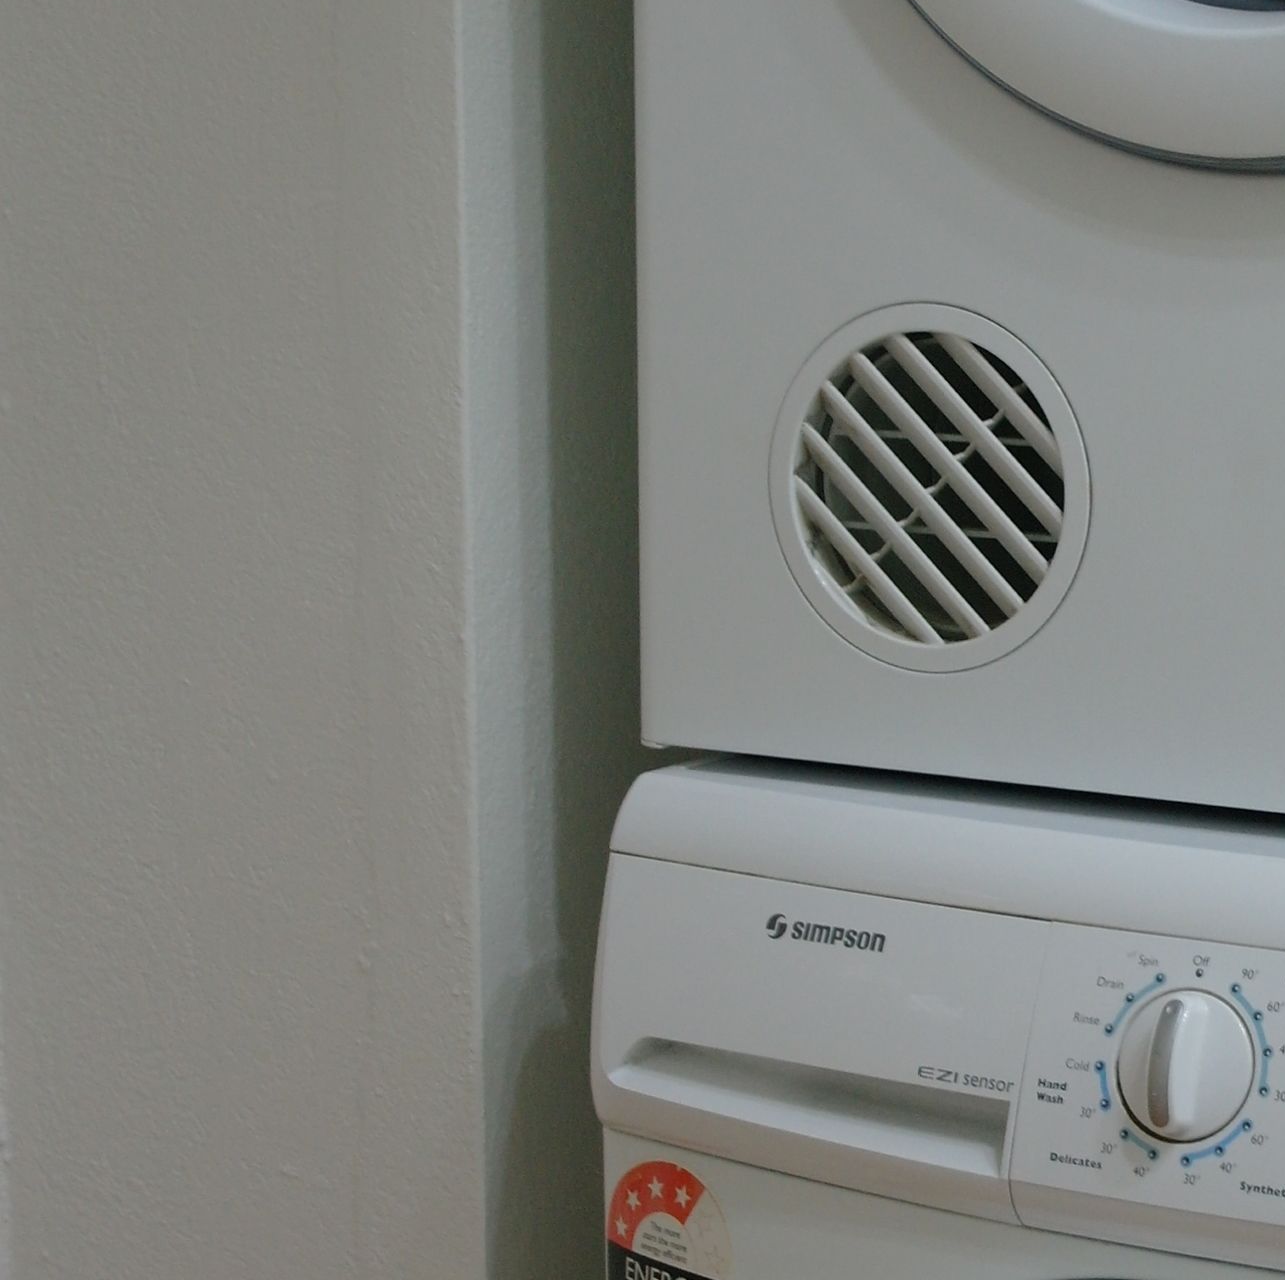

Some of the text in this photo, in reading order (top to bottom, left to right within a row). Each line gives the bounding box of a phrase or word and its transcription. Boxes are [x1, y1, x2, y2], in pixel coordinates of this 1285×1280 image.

[791, 920, 886, 952] SIMPSON
[1138, 954, 1159, 967] Spin
[1193, 955, 1210, 967] Off
[1096, 976, 1125, 989] Drain
[1073, 1011, 1100, 1025] Rinse
[1065, 1058, 1089, 1071] Cold
[963, 1074, 1014, 1093] sensor
[1037, 1078, 1067, 1091] Hand
[1036, 1091, 1064, 1104] Wash
[1049, 1152, 1102, 1169] Delicates
